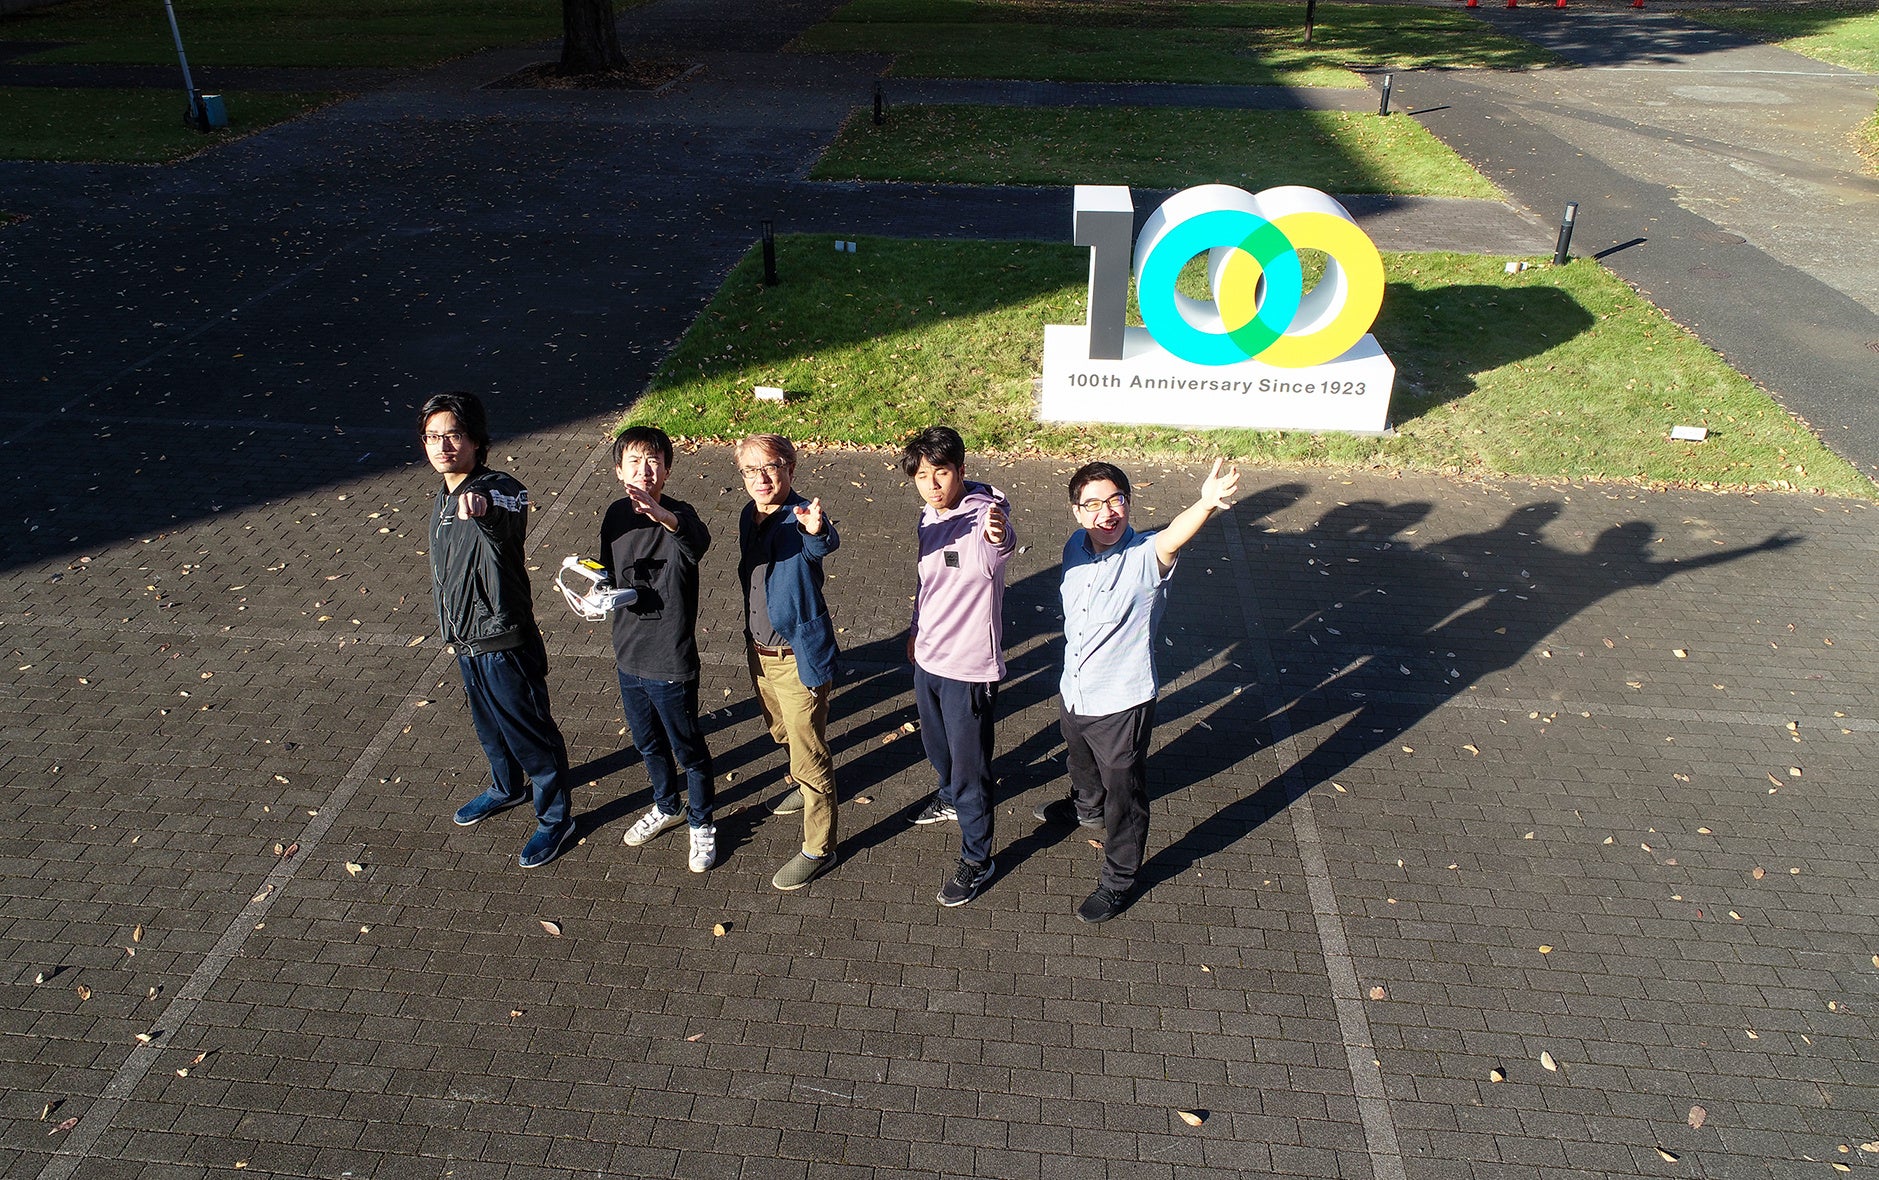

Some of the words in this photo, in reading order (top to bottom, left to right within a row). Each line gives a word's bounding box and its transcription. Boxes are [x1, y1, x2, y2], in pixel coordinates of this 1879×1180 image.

[1074, 206, 1386, 368] 100
[1068, 373, 1121, 388] 100th
[1129, 374, 1253, 395] Anniversary
[1258, 378, 1316, 394] Since
[1320, 380, 1366, 396] 1923
